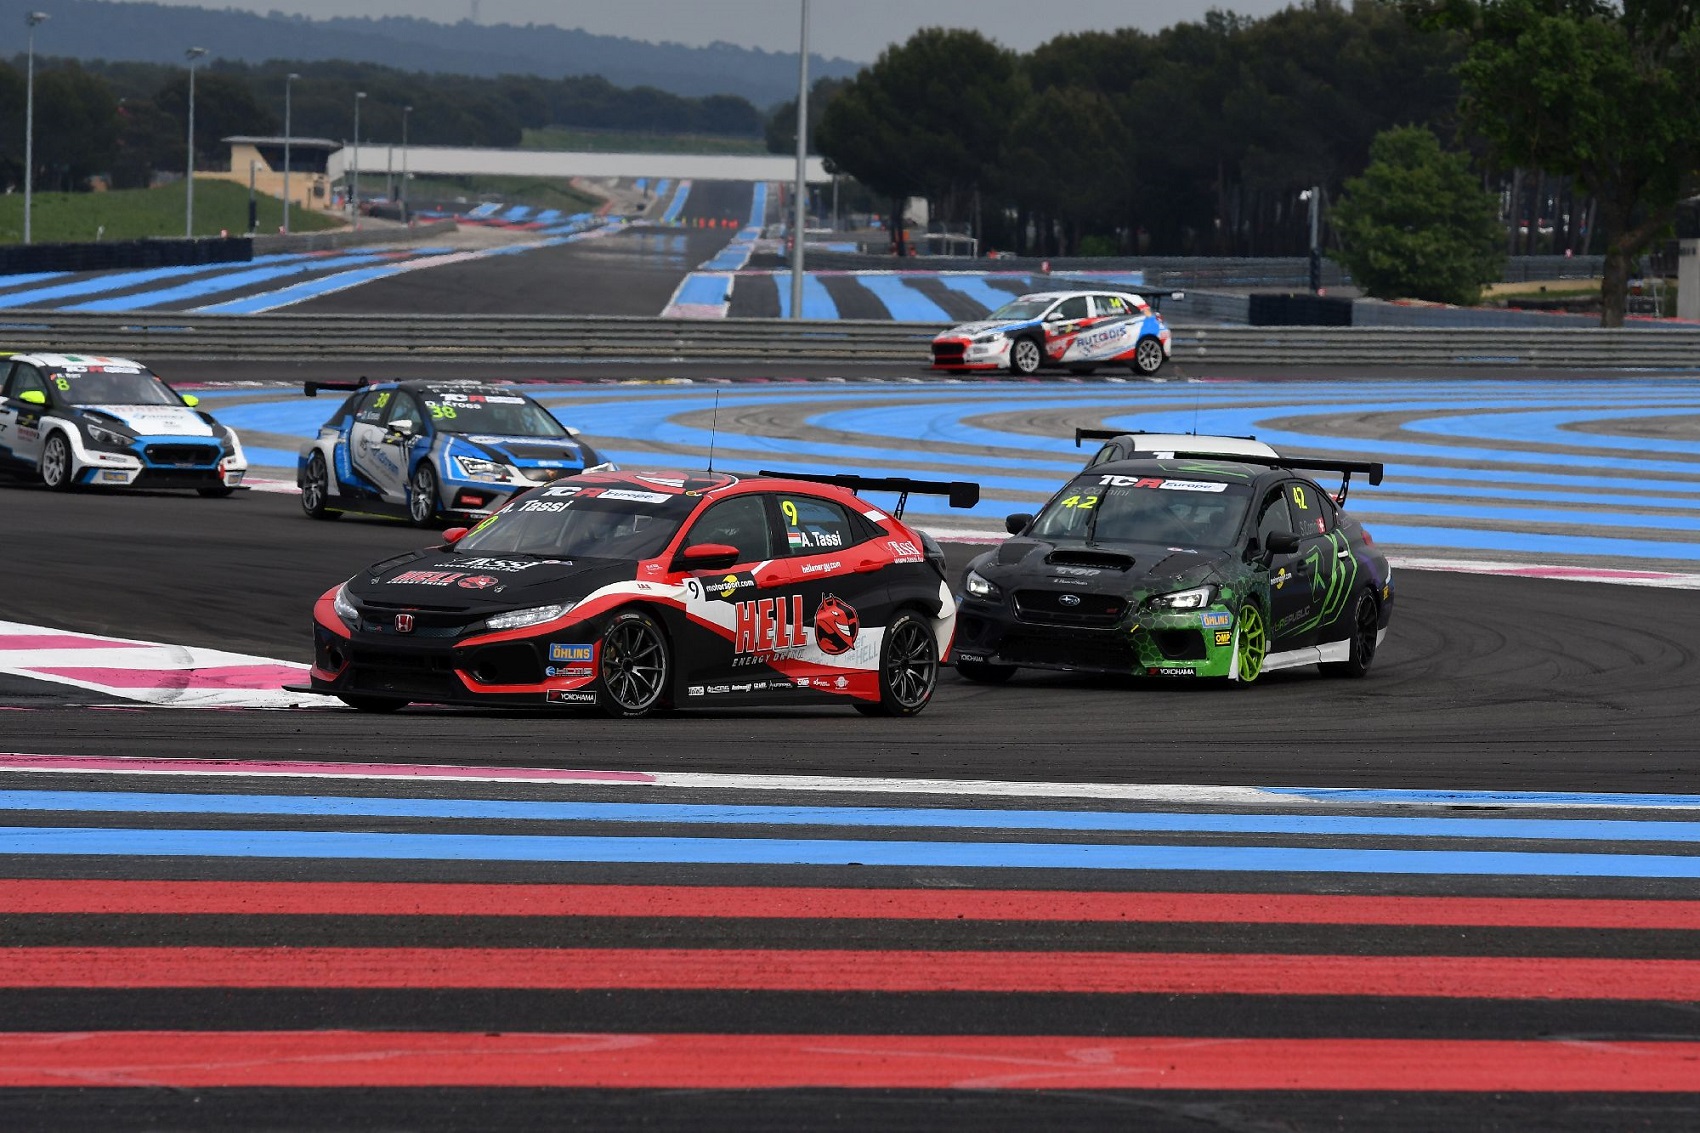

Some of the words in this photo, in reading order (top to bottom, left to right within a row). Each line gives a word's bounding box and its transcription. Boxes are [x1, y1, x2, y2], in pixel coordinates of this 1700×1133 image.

[56, 377, 70, 391] 8
[373, 392, 390, 408] 38
[440, 393, 487, 403] TCR
[432, 405, 457, 419] 38
[1098, 474, 1164, 489] TCR
[1164, 481, 1212, 490] Europe
[541, 487, 608, 498] TCR
[605, 490, 654, 500] Europe
[1293, 487, 1307, 509] 42
[518, 498, 573, 513] Tassi
[1061, 495, 1098, 509] 42
[782, 500, 798, 526] 9
[469, 515, 499, 537] 9
[801, 533, 815, 548] A.
[814, 530, 843, 547] Tassi
[802, 561, 841, 573] hellenergy.com
[391, 570, 465, 584] HELL
[688, 581, 700, 600] 9
[706, 579, 754, 593] motorsport.com
[734, 594, 807, 654] HELL
[1203, 614, 1228, 626] ÖHLINS
[1215, 634, 1230, 642] OMP
[553, 645, 590, 659] ÖHLINS
[732, 654, 770, 667] ENERGY
[773, 649, 806, 662] DRINK
[561, 693, 594, 701] YOKOHAMA
